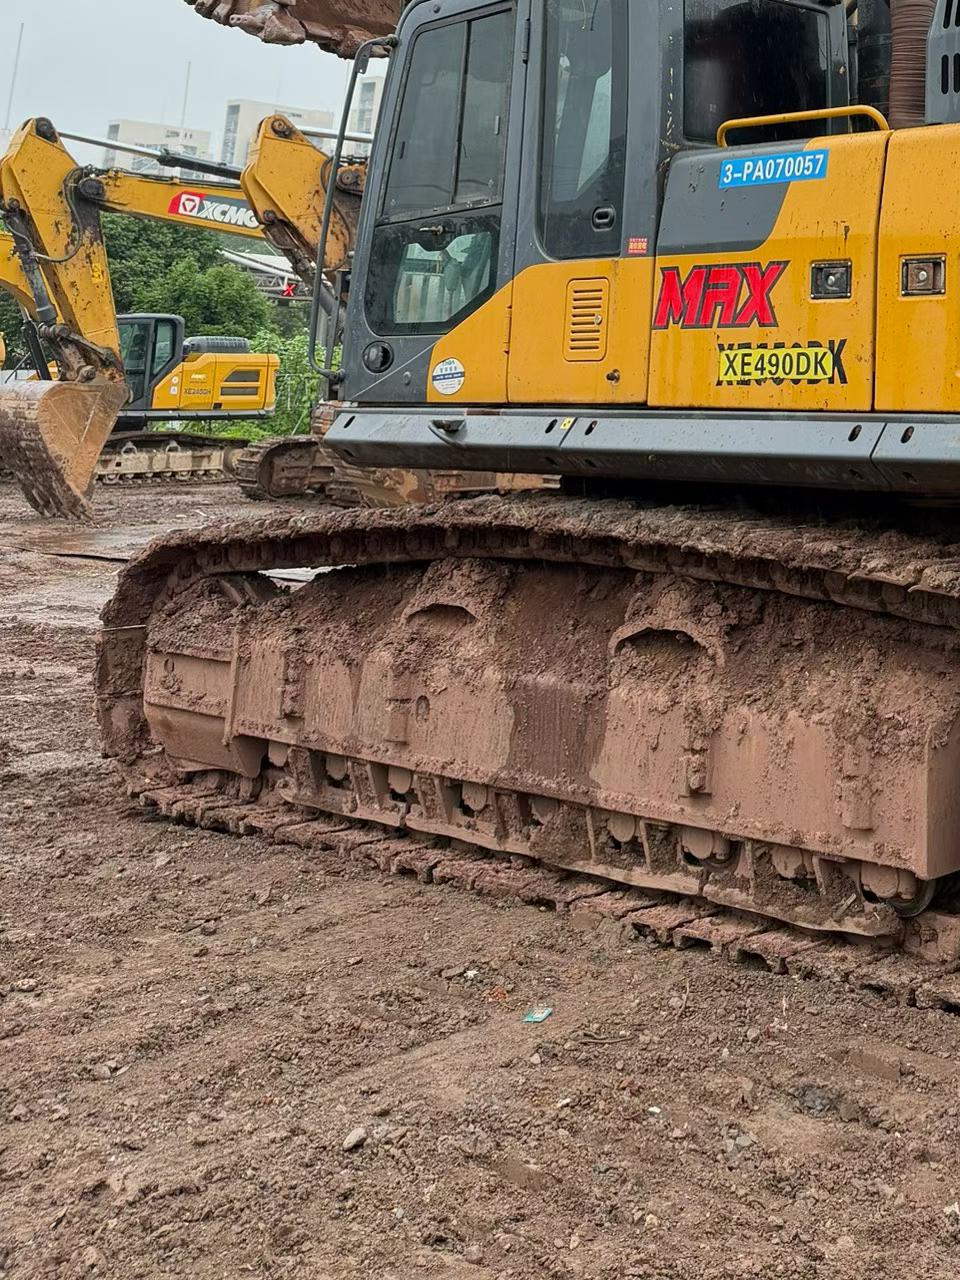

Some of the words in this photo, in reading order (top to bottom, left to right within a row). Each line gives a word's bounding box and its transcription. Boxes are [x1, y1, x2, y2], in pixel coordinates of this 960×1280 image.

[723, 154, 824, 183] 3-PA070057
[197, 200, 259, 228] XCMG
[652, 260, 791, 329] MAX
[723, 351, 828, 377] XE490DK
